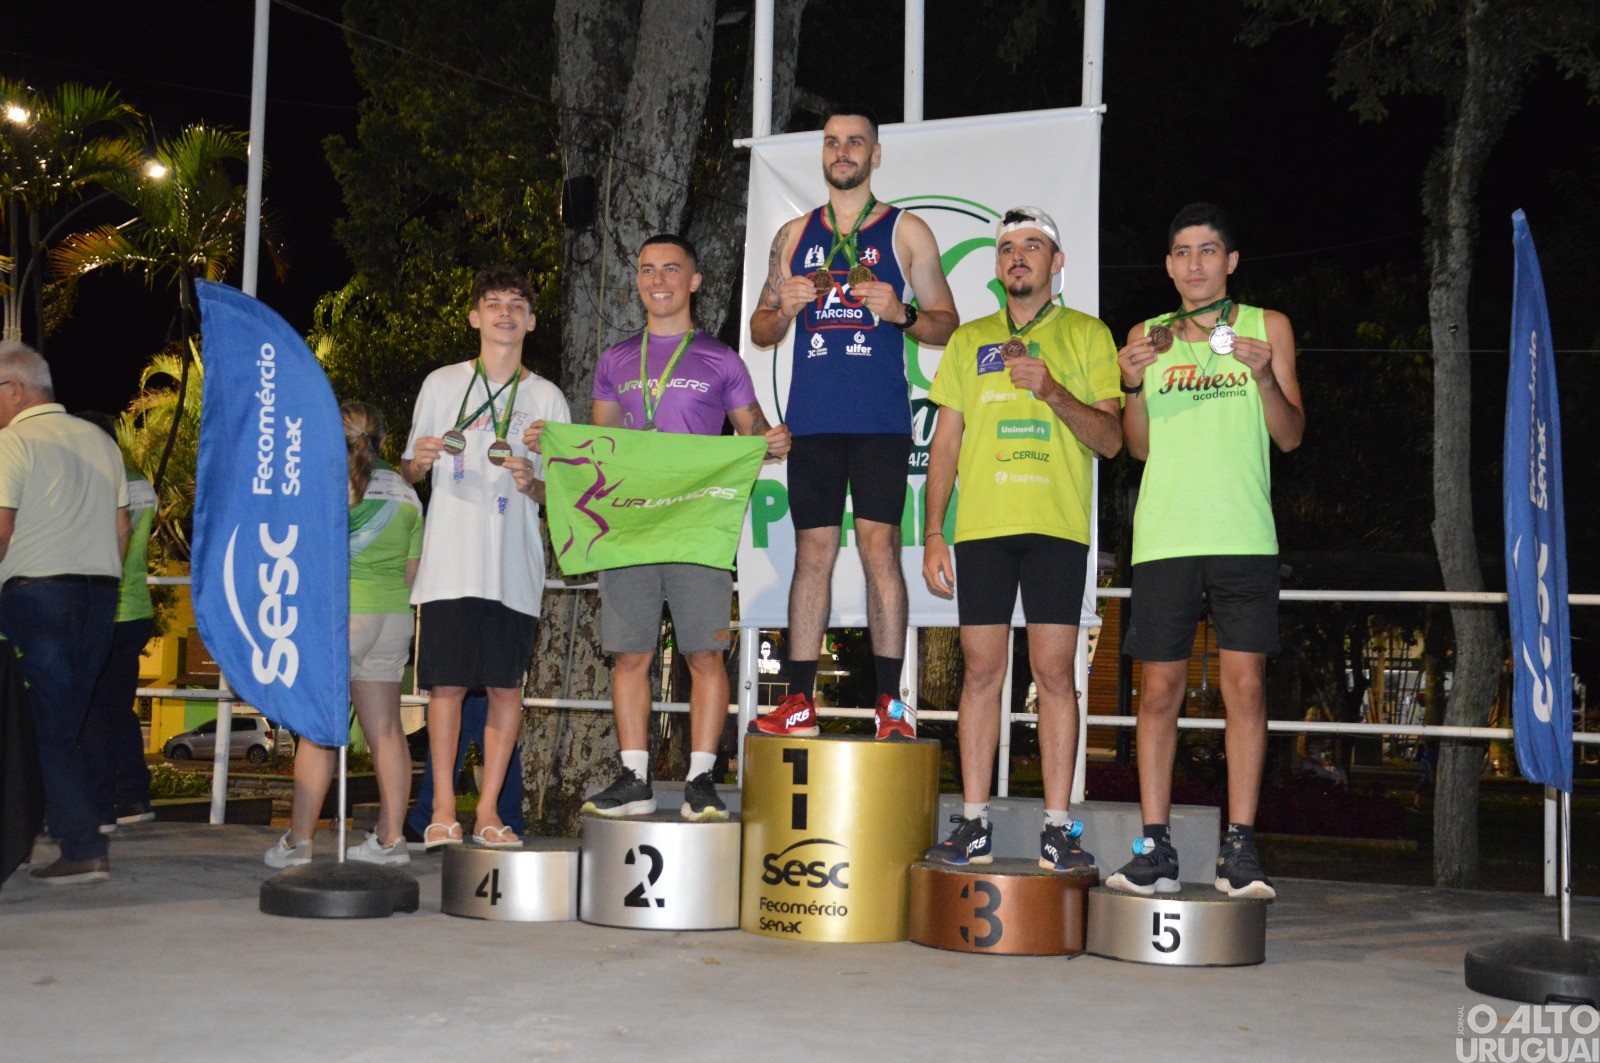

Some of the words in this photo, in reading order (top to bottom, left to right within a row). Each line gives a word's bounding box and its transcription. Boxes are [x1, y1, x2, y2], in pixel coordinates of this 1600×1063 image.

[815, 308, 863, 320] TARCISO
[845, 344, 872, 353] ulfer
[1159, 365, 1248, 394] Fitness
[1192, 388, 1247, 400] academia
[252, 343, 275, 496] Fecomércio
[1001, 425, 1034, 434] Unimed
[282, 417, 303, 496] Senac
[1012, 450, 1050, 463] CERILUZ
[1536, 418, 1547, 511] Senac
[783, 748, 809, 830] 1
[475, 868, 503, 906] 4
[624, 844, 666, 908] 2
[759, 896, 848, 917] Fecomércio
[960, 880, 1004, 948] 3
[759, 916, 803, 934] Senac
[1152, 911, 1181, 953] 5
